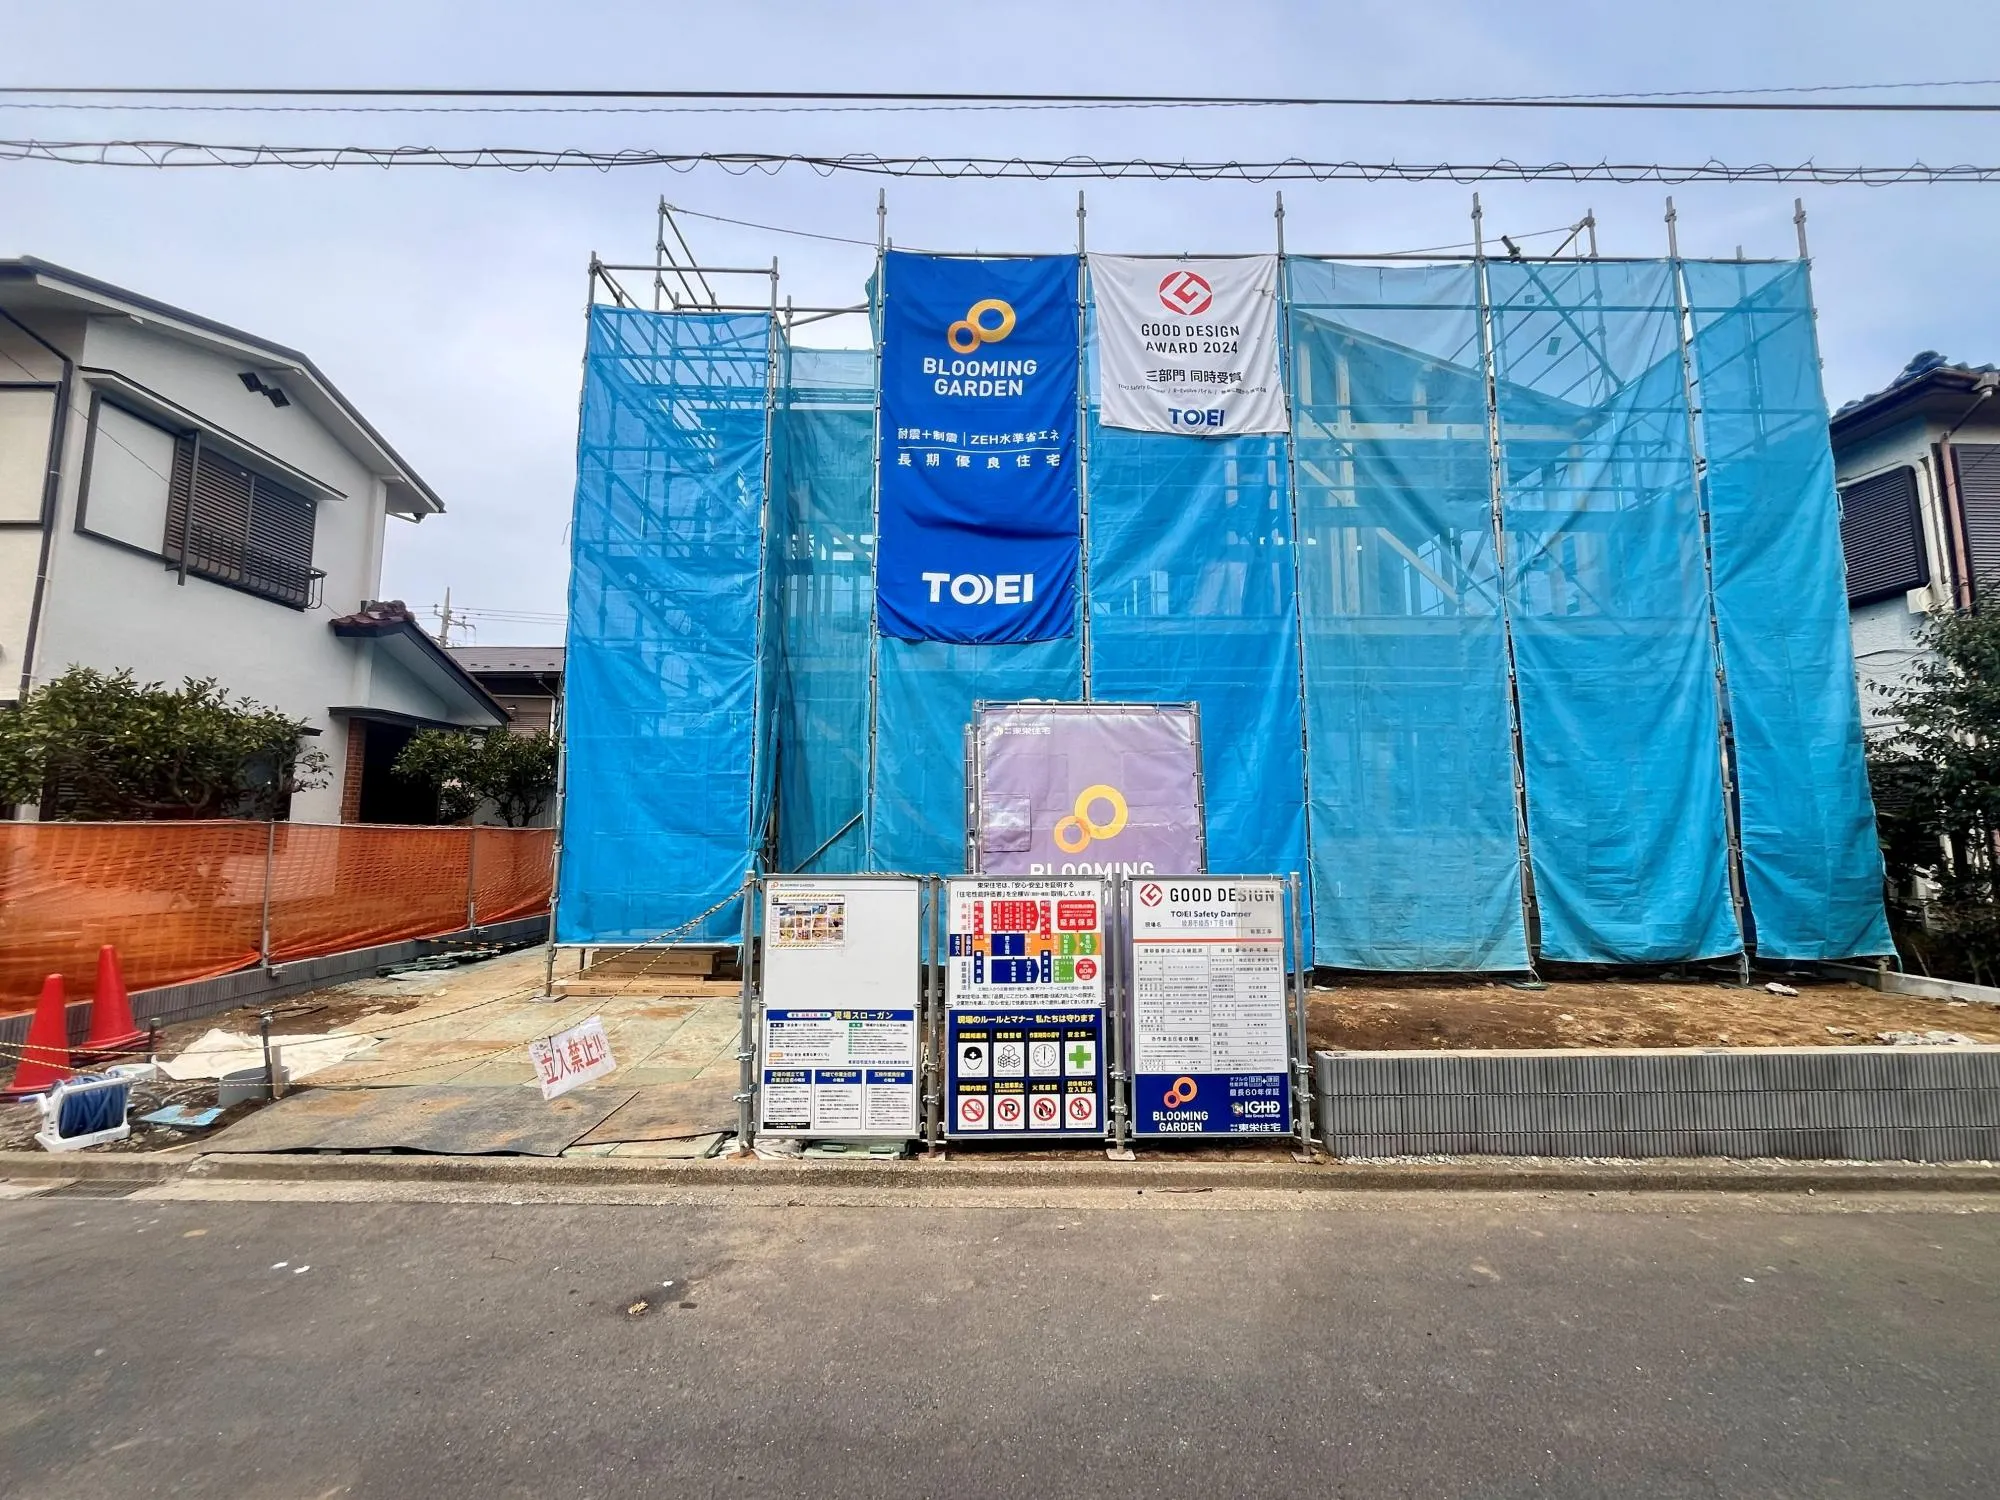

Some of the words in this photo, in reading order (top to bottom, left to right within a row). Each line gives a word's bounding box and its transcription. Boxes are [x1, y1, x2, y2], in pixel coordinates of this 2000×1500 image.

[1141, 323, 1181, 337] GOOD
[1186, 325, 1240, 337] DESIGN
[1146, 341, 1198, 354] AWARD
[1203, 341, 1239, 354] 2024
[922, 357, 1038, 377] BLOOMING
[1146, 369, 1186, 383] 三部門
[1190, 370, 1242, 384] 同時受賞
[933, 378, 1024, 397] GARDEN
[970, 429, 1060, 445] ZEH水準省エネ
[898, 453, 1061, 469] 長期優良住宅
[1030, 862, 1155, 876] BLOOMING
[1170, 887, 1212, 902] GOOD
[1217, 887, 1275, 903] DESIGN
[1193, 910, 1219, 919] Safety
[1220, 911, 1251, 919] Damper
[833, 1011, 894, 1020] 現場スローガン
[957, 1015, 1034, 1024] 現場のルールとマナー
[1035, 1014, 1096, 1023] 私たちは守ります
[1229, 1088, 1280, 1096] 最長60年保証
[1245, 1100, 1281, 1114] IGHD
[1152, 1111, 1209, 1121] BLOOMING
[1159, 1122, 1203, 1132] GARDEN
[1238, 1123, 1281, 1132] 東栄住宅
